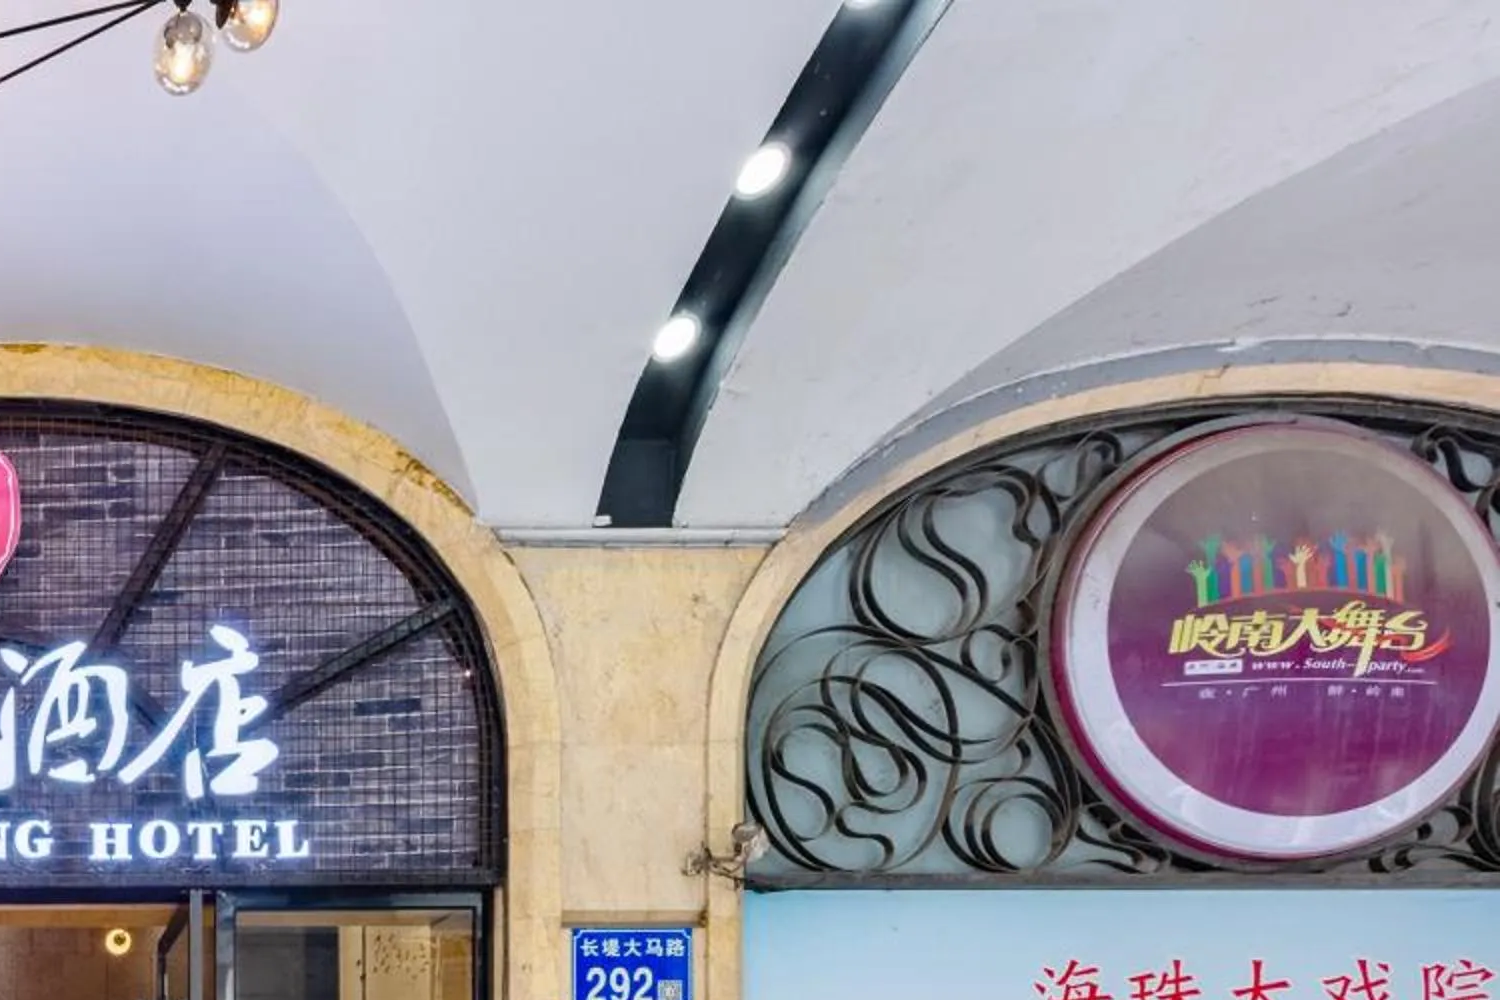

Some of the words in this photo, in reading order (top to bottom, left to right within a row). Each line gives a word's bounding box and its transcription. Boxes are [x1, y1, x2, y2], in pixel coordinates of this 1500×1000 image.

[1169, 600, 1428, 677] 岭南大舞台
[88, 820, 310, 861] HOTEL
[580, 938, 685, 957] 长堤大马路
